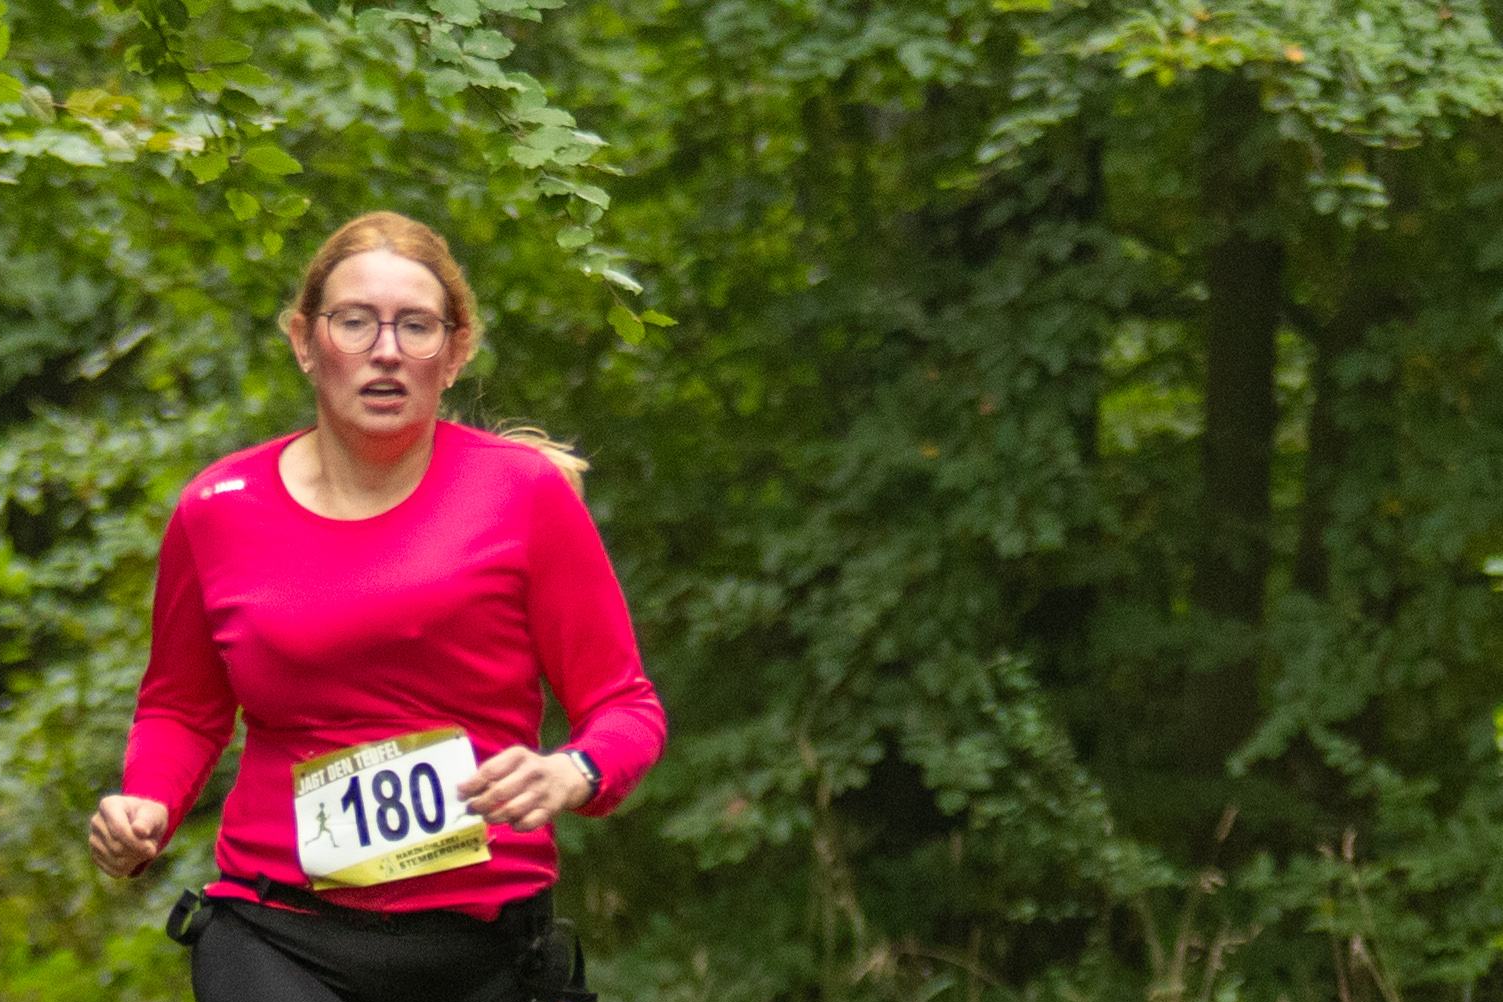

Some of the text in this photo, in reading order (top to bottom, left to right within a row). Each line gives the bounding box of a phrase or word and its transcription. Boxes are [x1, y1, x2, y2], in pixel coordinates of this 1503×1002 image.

[299, 741, 402, 795] JAGT DEN TEUFEL
[341, 762, 445, 847] 180
